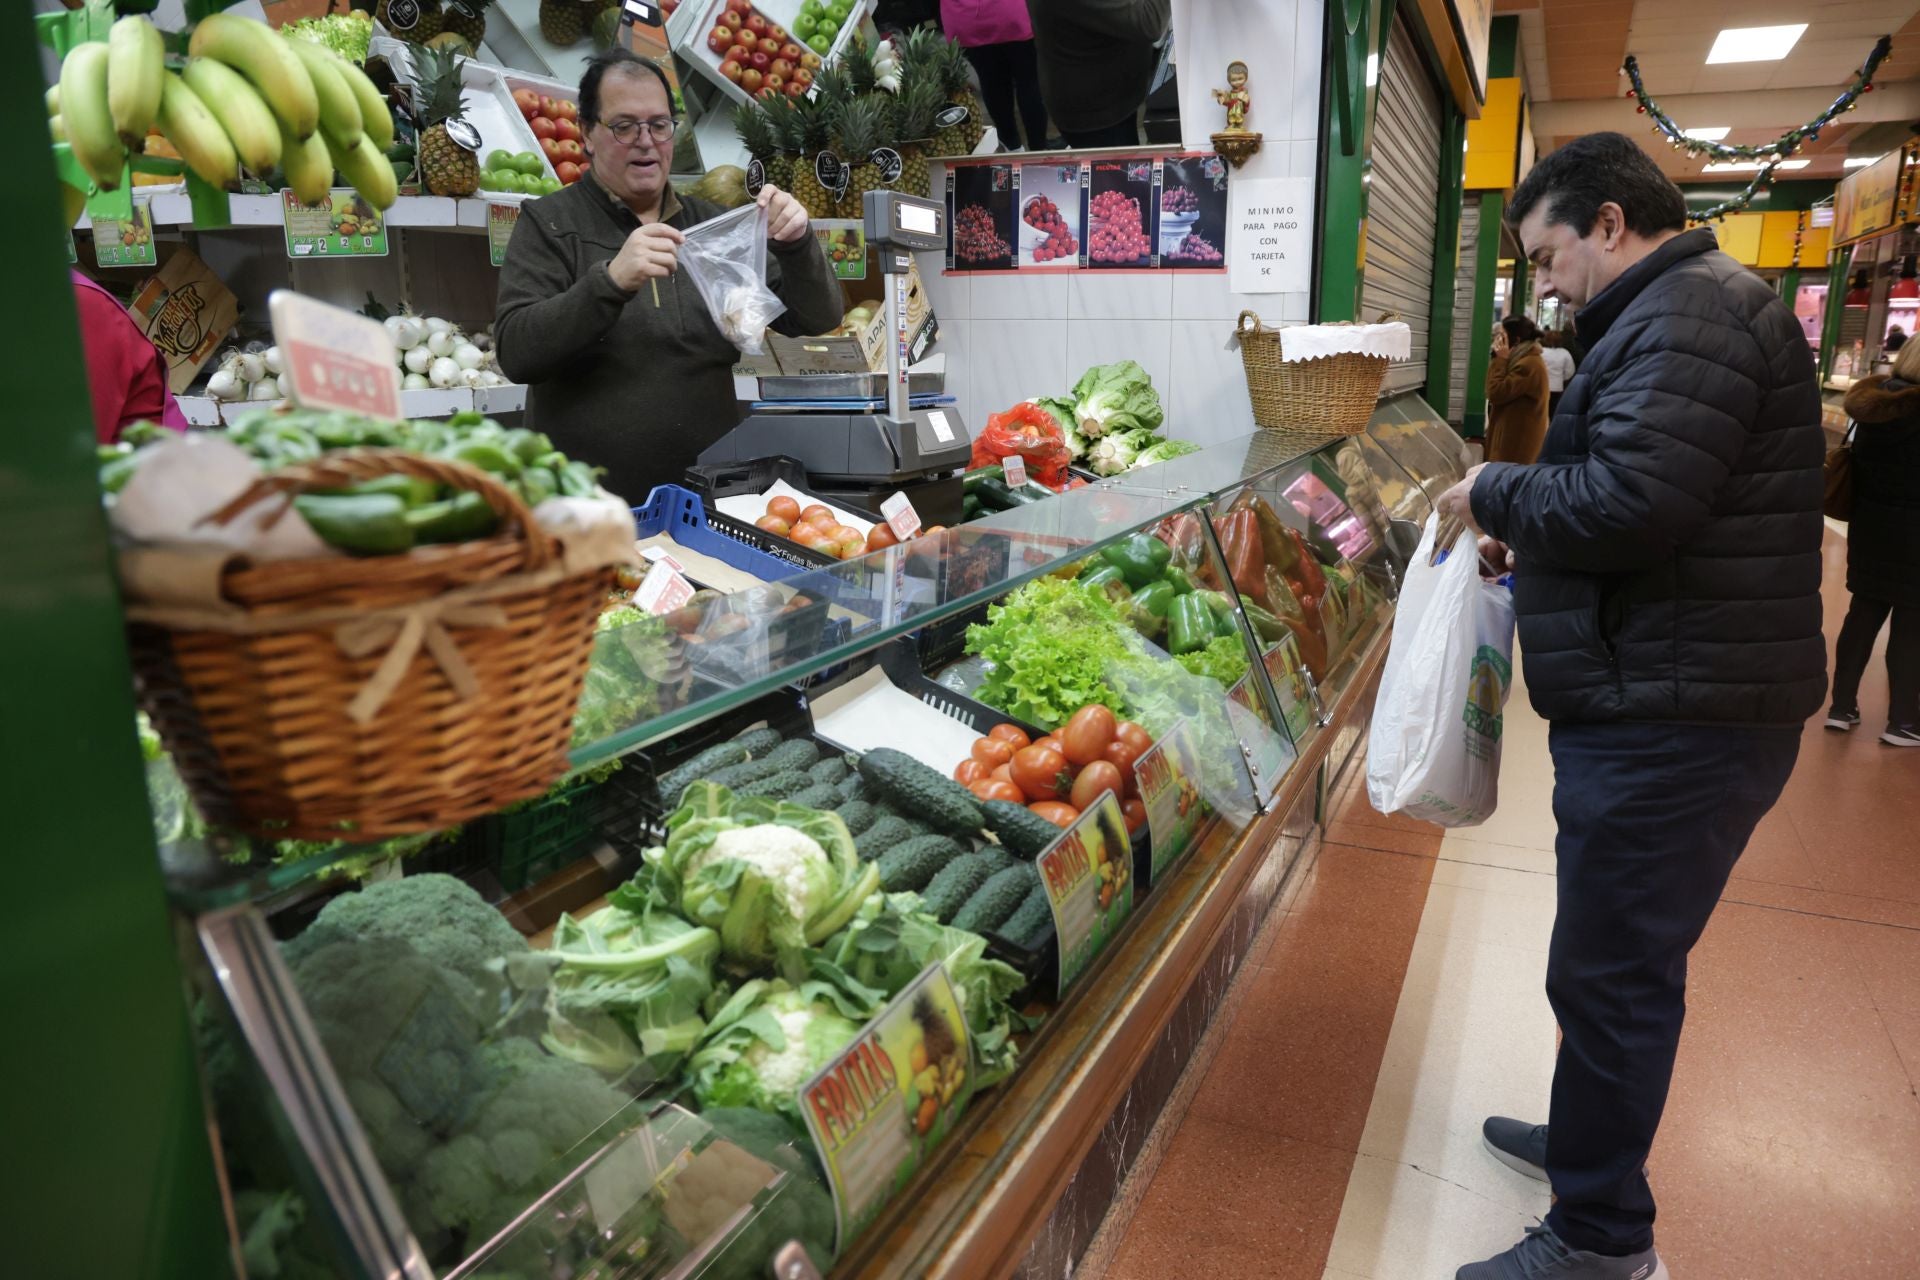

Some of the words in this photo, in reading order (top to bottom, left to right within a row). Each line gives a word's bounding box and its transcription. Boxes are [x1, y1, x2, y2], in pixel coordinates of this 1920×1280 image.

[1247, 206, 1294, 216] MINIMO
[1243, 223, 1265, 231] PARA
[1273, 221, 1298, 230] PAGO
[1259, 237, 1278, 245] CON
[1251, 252, 1285, 261] TARJETA
[1261, 267, 1271, 275] 5€
[781, 549, 805, 566] Frutas
[1041, 828, 1090, 905] FRUTAS
[806, 1031, 897, 1153] FRUTAS
